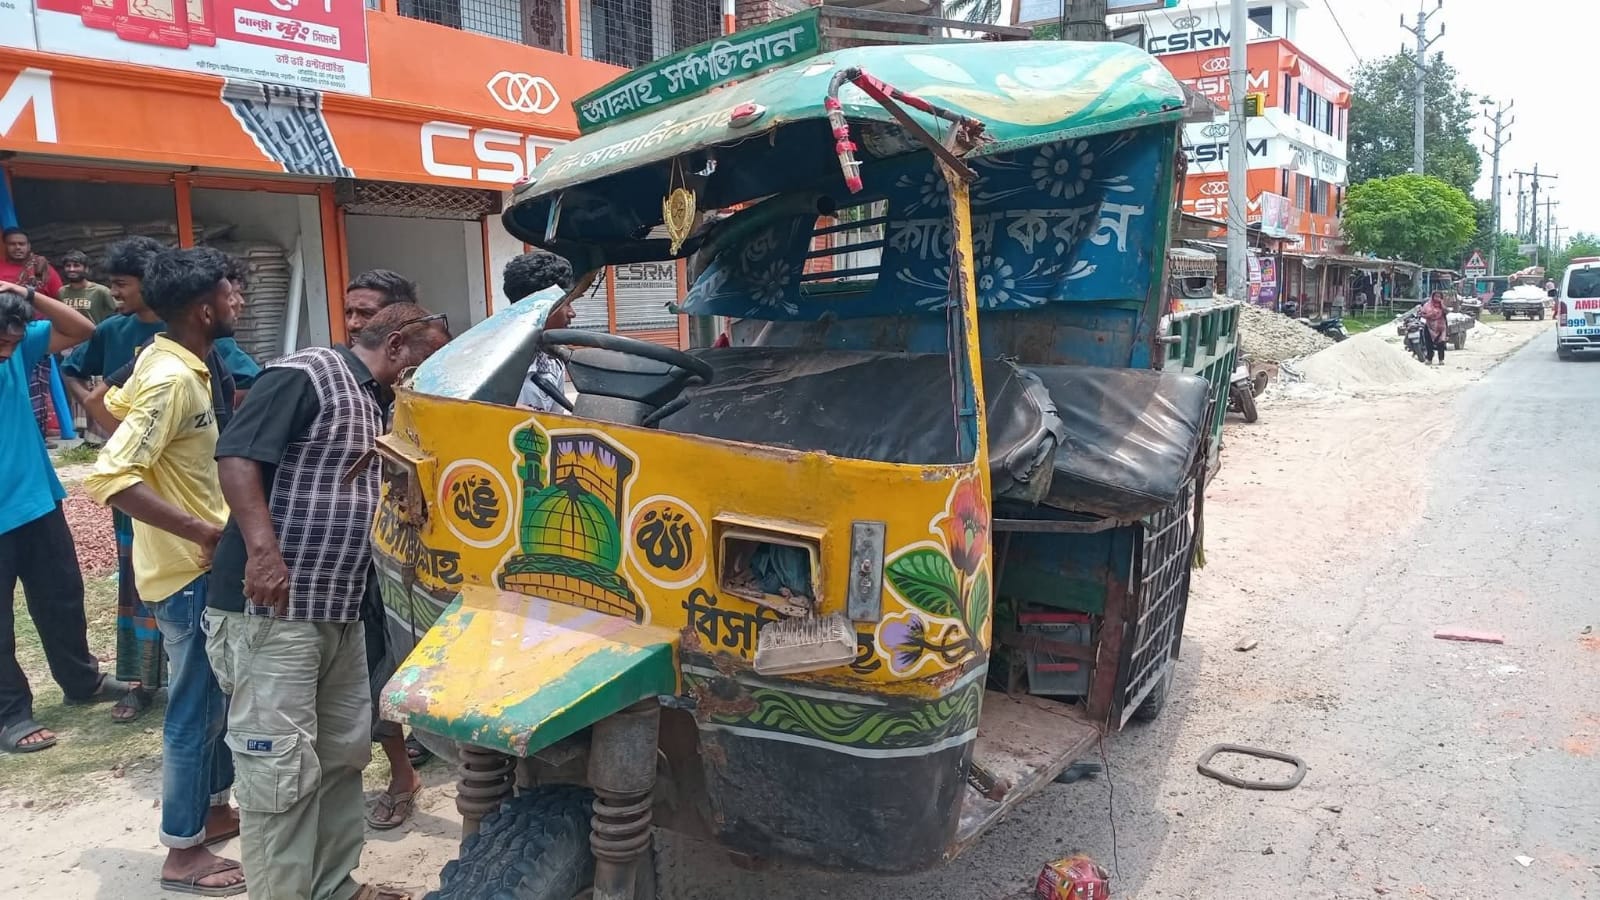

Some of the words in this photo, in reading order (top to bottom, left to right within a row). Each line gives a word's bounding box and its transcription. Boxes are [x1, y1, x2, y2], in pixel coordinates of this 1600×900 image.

[1177, 70, 1269, 96] SM
[582, 72, 663, 123] আল্লাহ
[616, 263, 673, 281] CSRM
